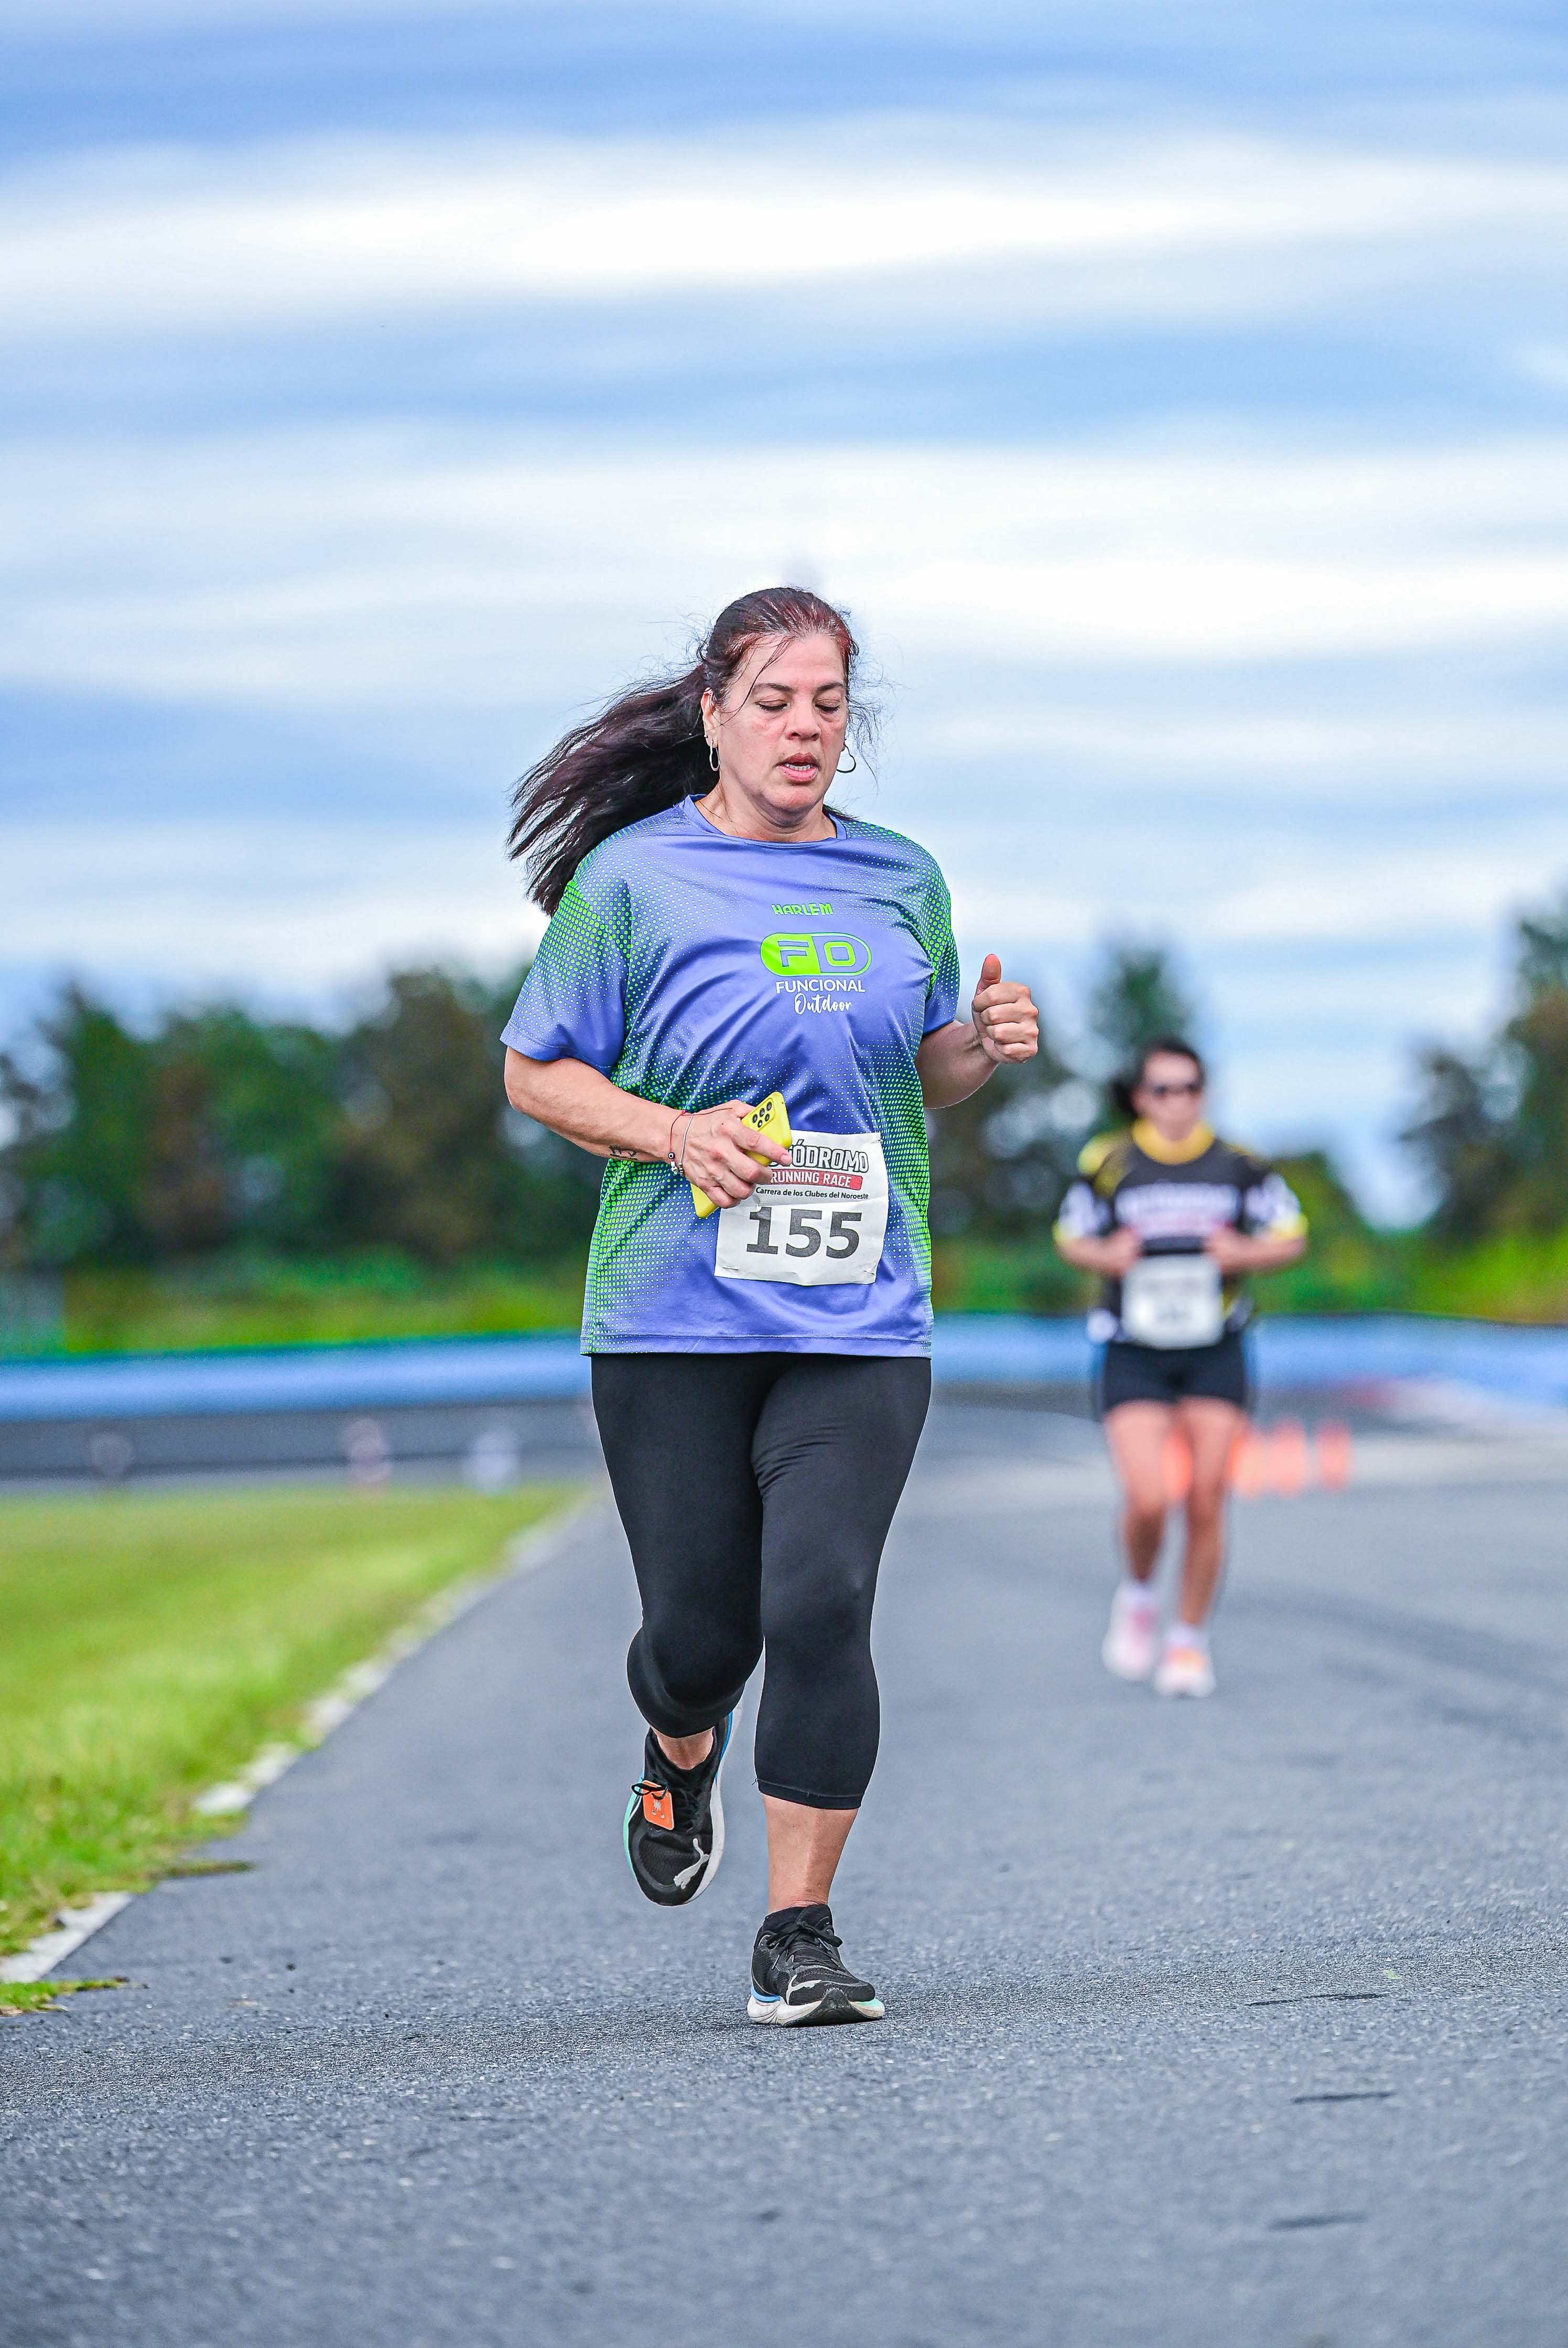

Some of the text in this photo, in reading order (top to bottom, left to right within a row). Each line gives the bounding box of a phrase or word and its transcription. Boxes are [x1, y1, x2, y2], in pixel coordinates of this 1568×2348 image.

[772, 902, 834, 915] HARLEM
[775, 979, 866, 994] FUNCIONAL
[794, 993, 852, 1015] Outdoor
[769, 1139, 869, 1173] ÓDROMO
[771, 1170, 852, 1188] RUNNING RACE
[755, 1187, 781, 1195] Carrera
[747, 1207, 862, 1258] 155
